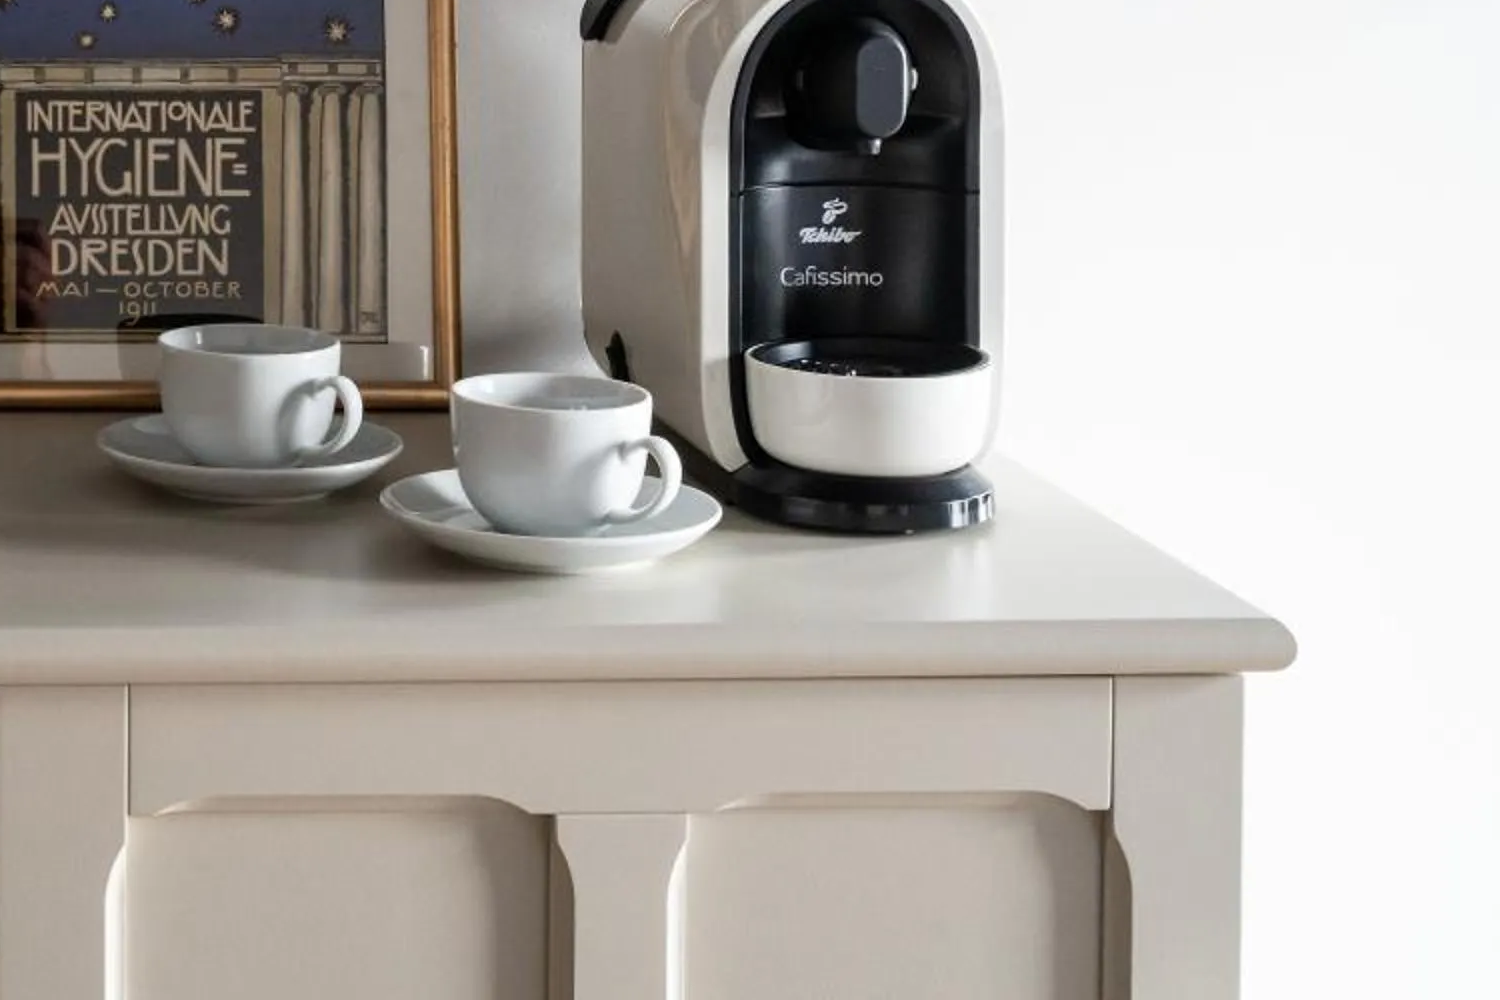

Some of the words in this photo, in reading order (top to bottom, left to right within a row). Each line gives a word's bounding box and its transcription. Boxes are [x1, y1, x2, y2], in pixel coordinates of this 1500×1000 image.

[26, 101, 256, 132] INTERNATIONALE
[799, 227, 862, 244] Tchibo
[51, 238, 229, 276] DRESDEN
[780, 265, 884, 287] Cafissimo
[35, 281, 89, 298] MAI
[123, 280, 241, 299] OCTOBER
[118, 302, 157, 326] 1911
